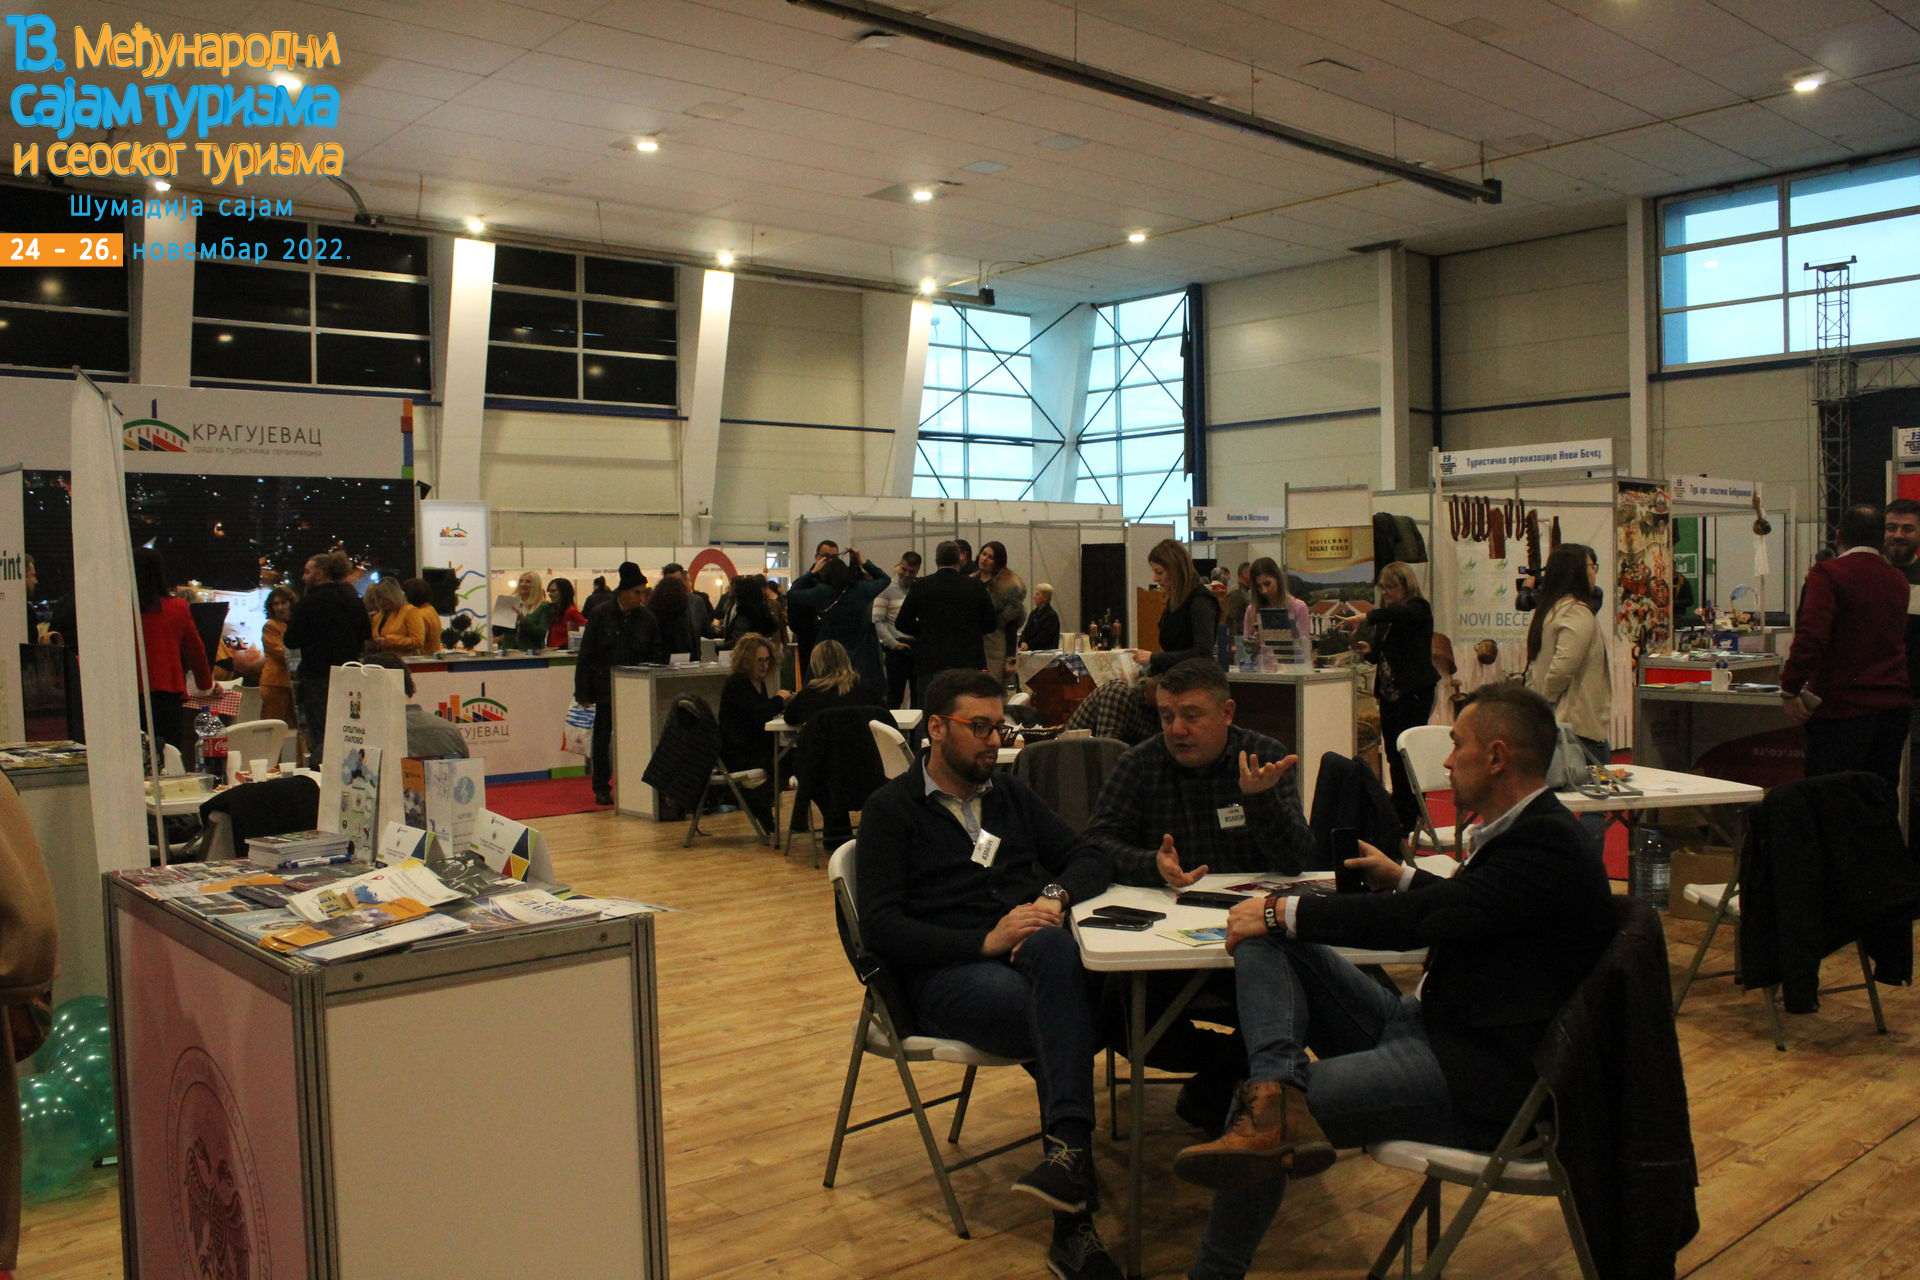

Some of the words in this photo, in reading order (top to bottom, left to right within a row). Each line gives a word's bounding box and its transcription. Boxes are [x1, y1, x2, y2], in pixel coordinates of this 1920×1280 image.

[192, 423, 322, 447] КРАГУЈЕВАЦ
[1559, 452, 1578, 461] Нови
[1580, 449, 1602, 460] Бечеј
[0, 550, 22, 580] int
[1459, 612, 1491, 627] NOVI
[460, 725, 509, 739] ГУЈЕВАЦ
